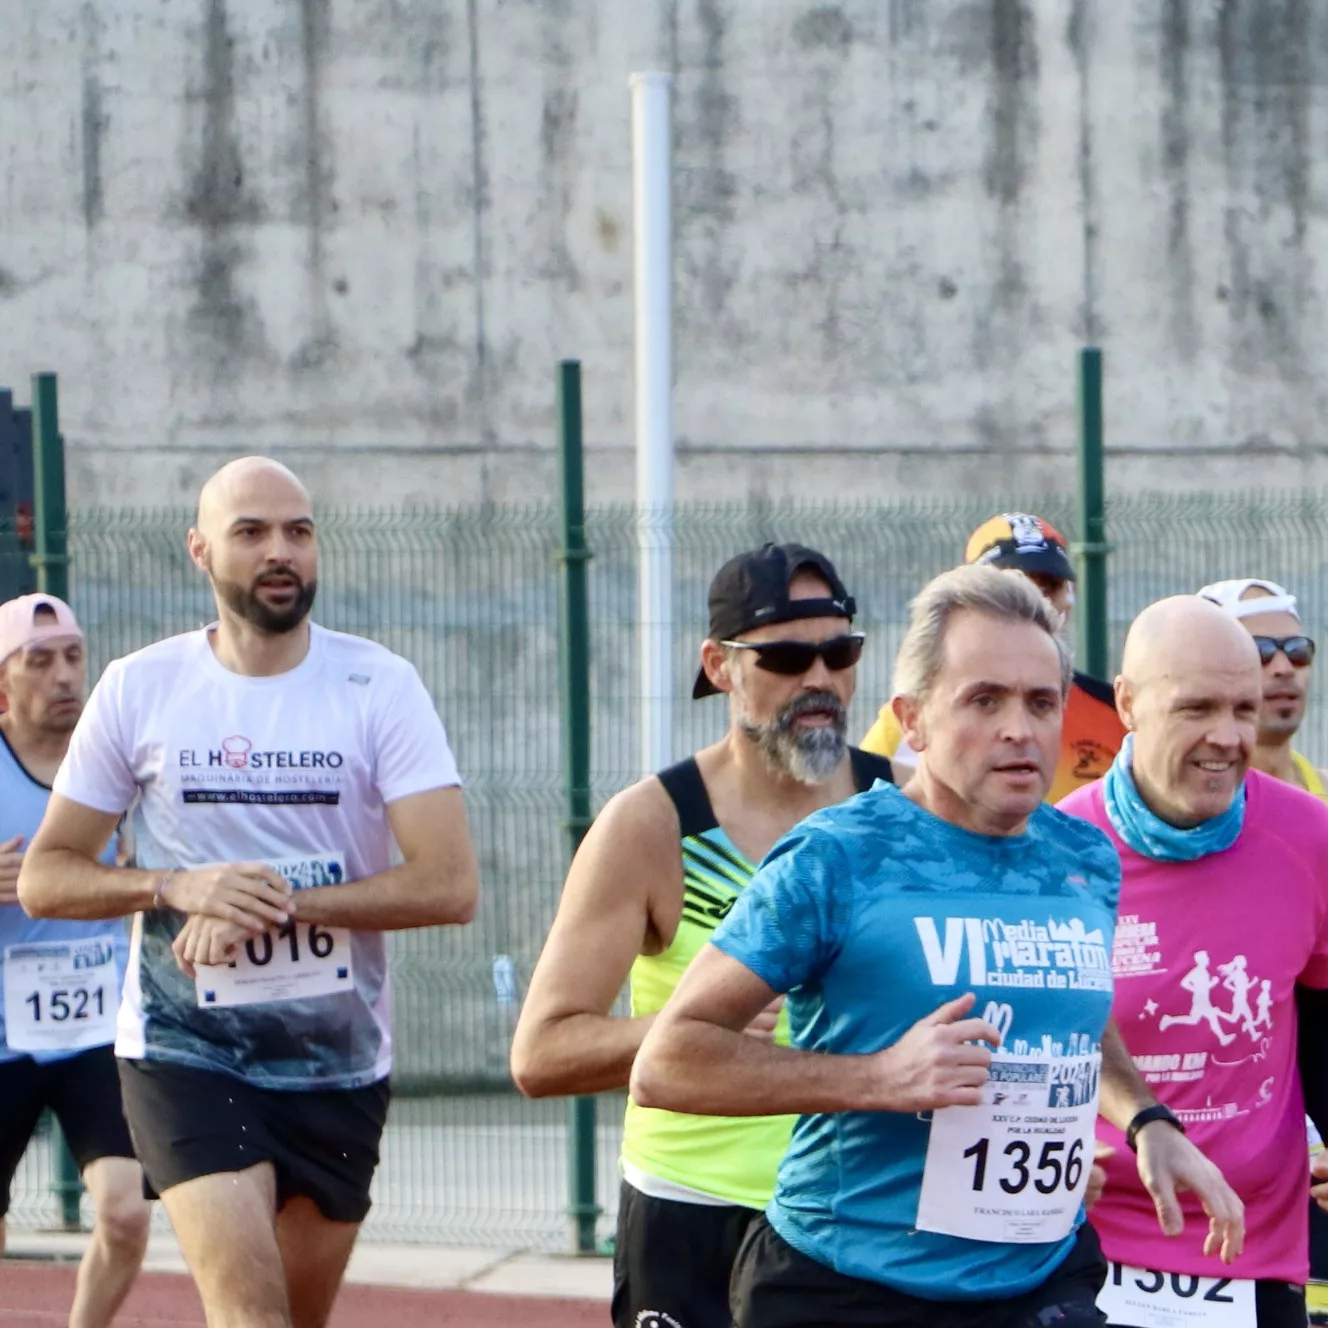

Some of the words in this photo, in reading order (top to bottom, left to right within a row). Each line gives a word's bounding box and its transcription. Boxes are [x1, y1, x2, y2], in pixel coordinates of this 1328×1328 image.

[179, 750, 201, 767] EL
[180, 774, 252, 784] MAQUINARIA
[256, 775, 270, 784] DE
[228, 913, 334, 968] 016
[913, 916, 987, 986] VI
[986, 968, 1045, 988] ciudad
[1047, 969, 1066, 989] de
[25, 984, 104, 1022] 1521
[963, 1137, 1084, 1195] 1356
